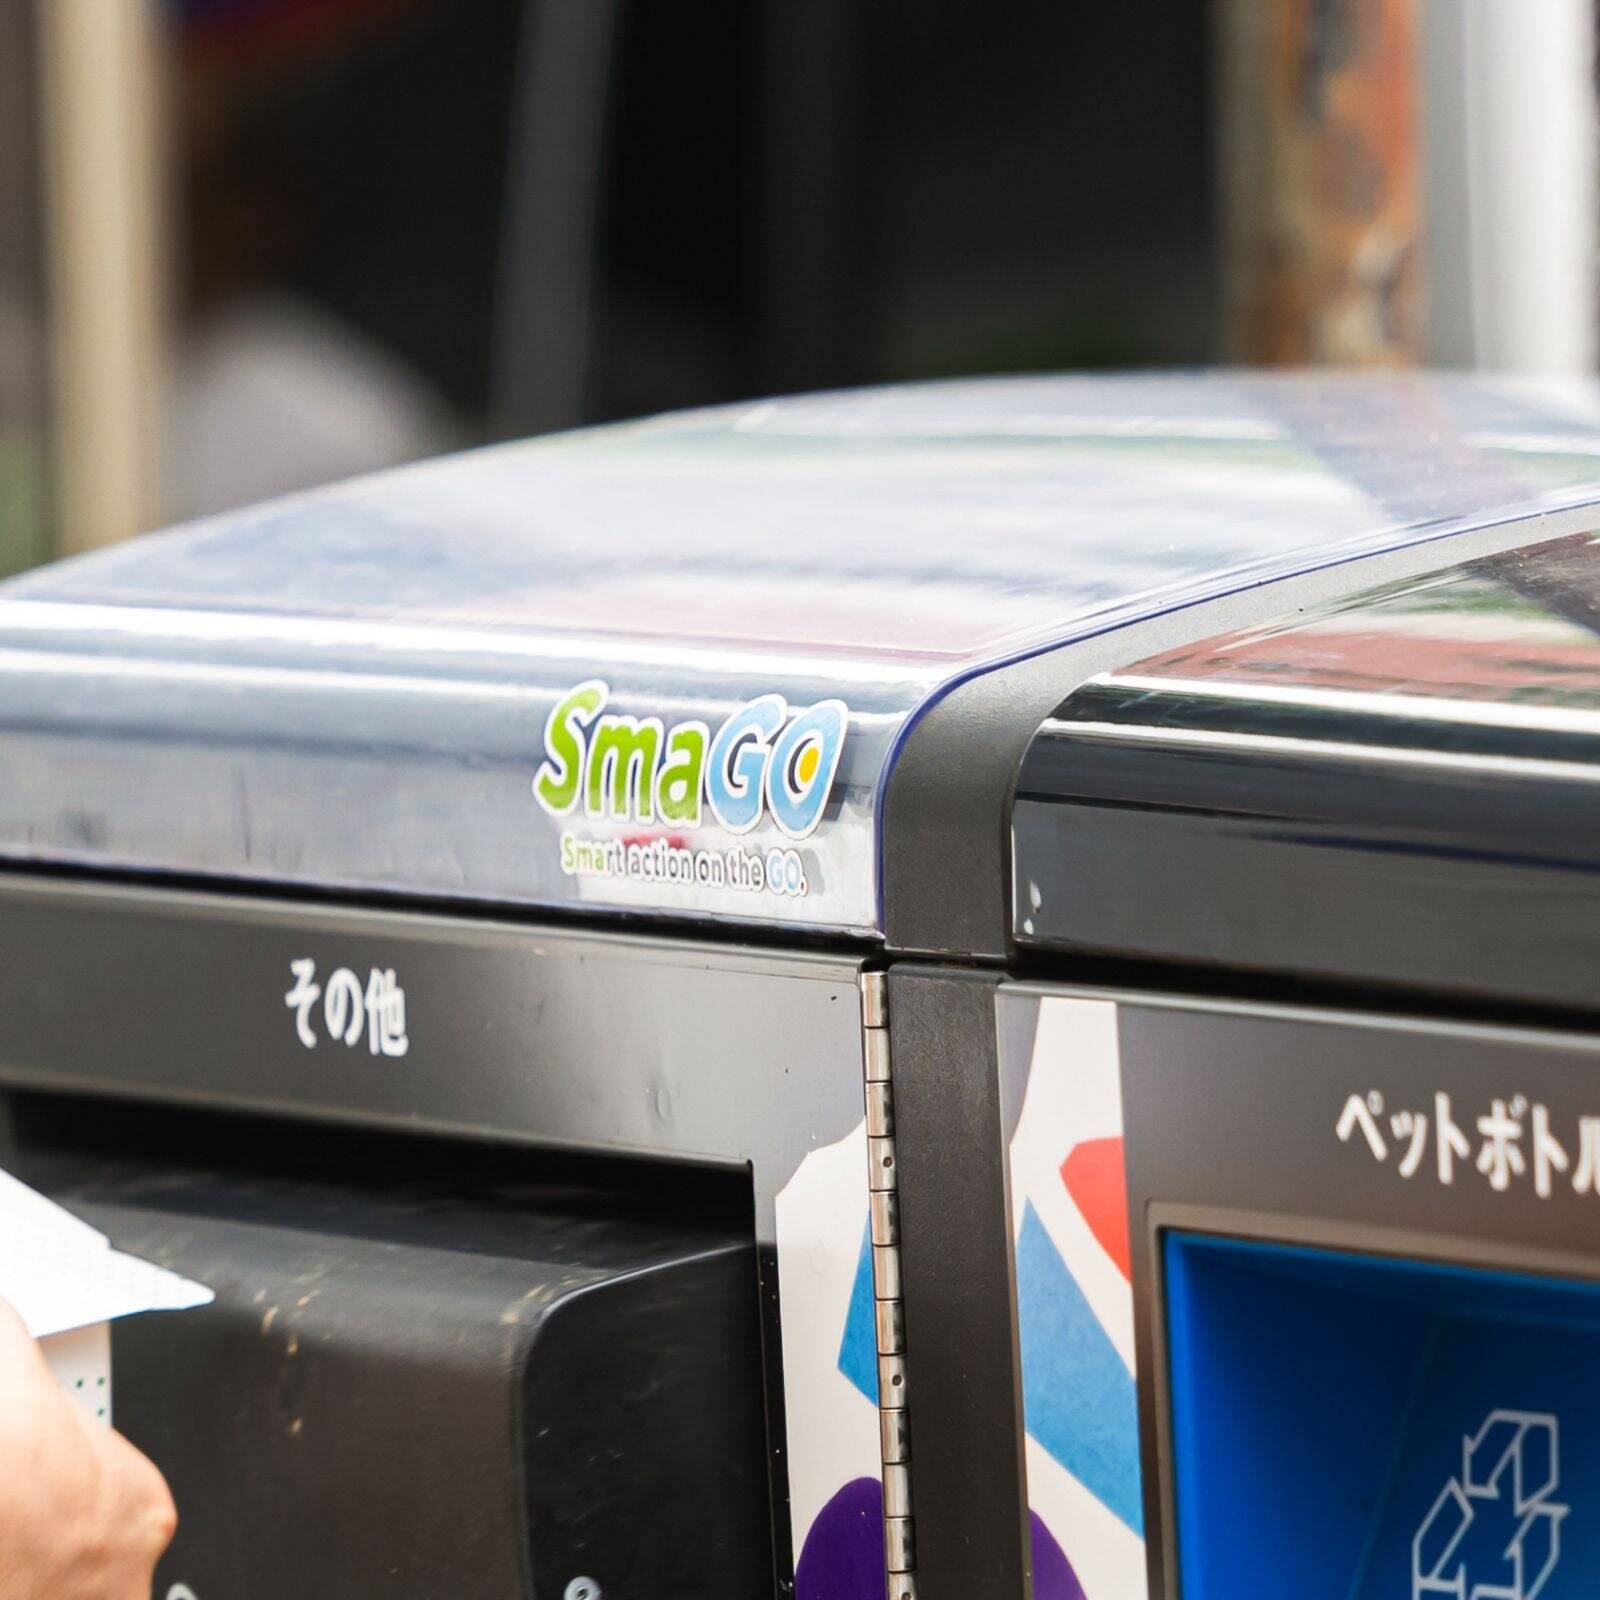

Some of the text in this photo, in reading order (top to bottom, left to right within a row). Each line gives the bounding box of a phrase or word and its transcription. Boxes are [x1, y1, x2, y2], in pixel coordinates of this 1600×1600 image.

[535, 684, 844, 836] SmaGO
[563, 836, 623, 873] Smart
[631, 841, 690, 879] action
[699, 856, 722, 884] on
[729, 847, 761, 886] the
[284, 957, 409, 1056] その他
